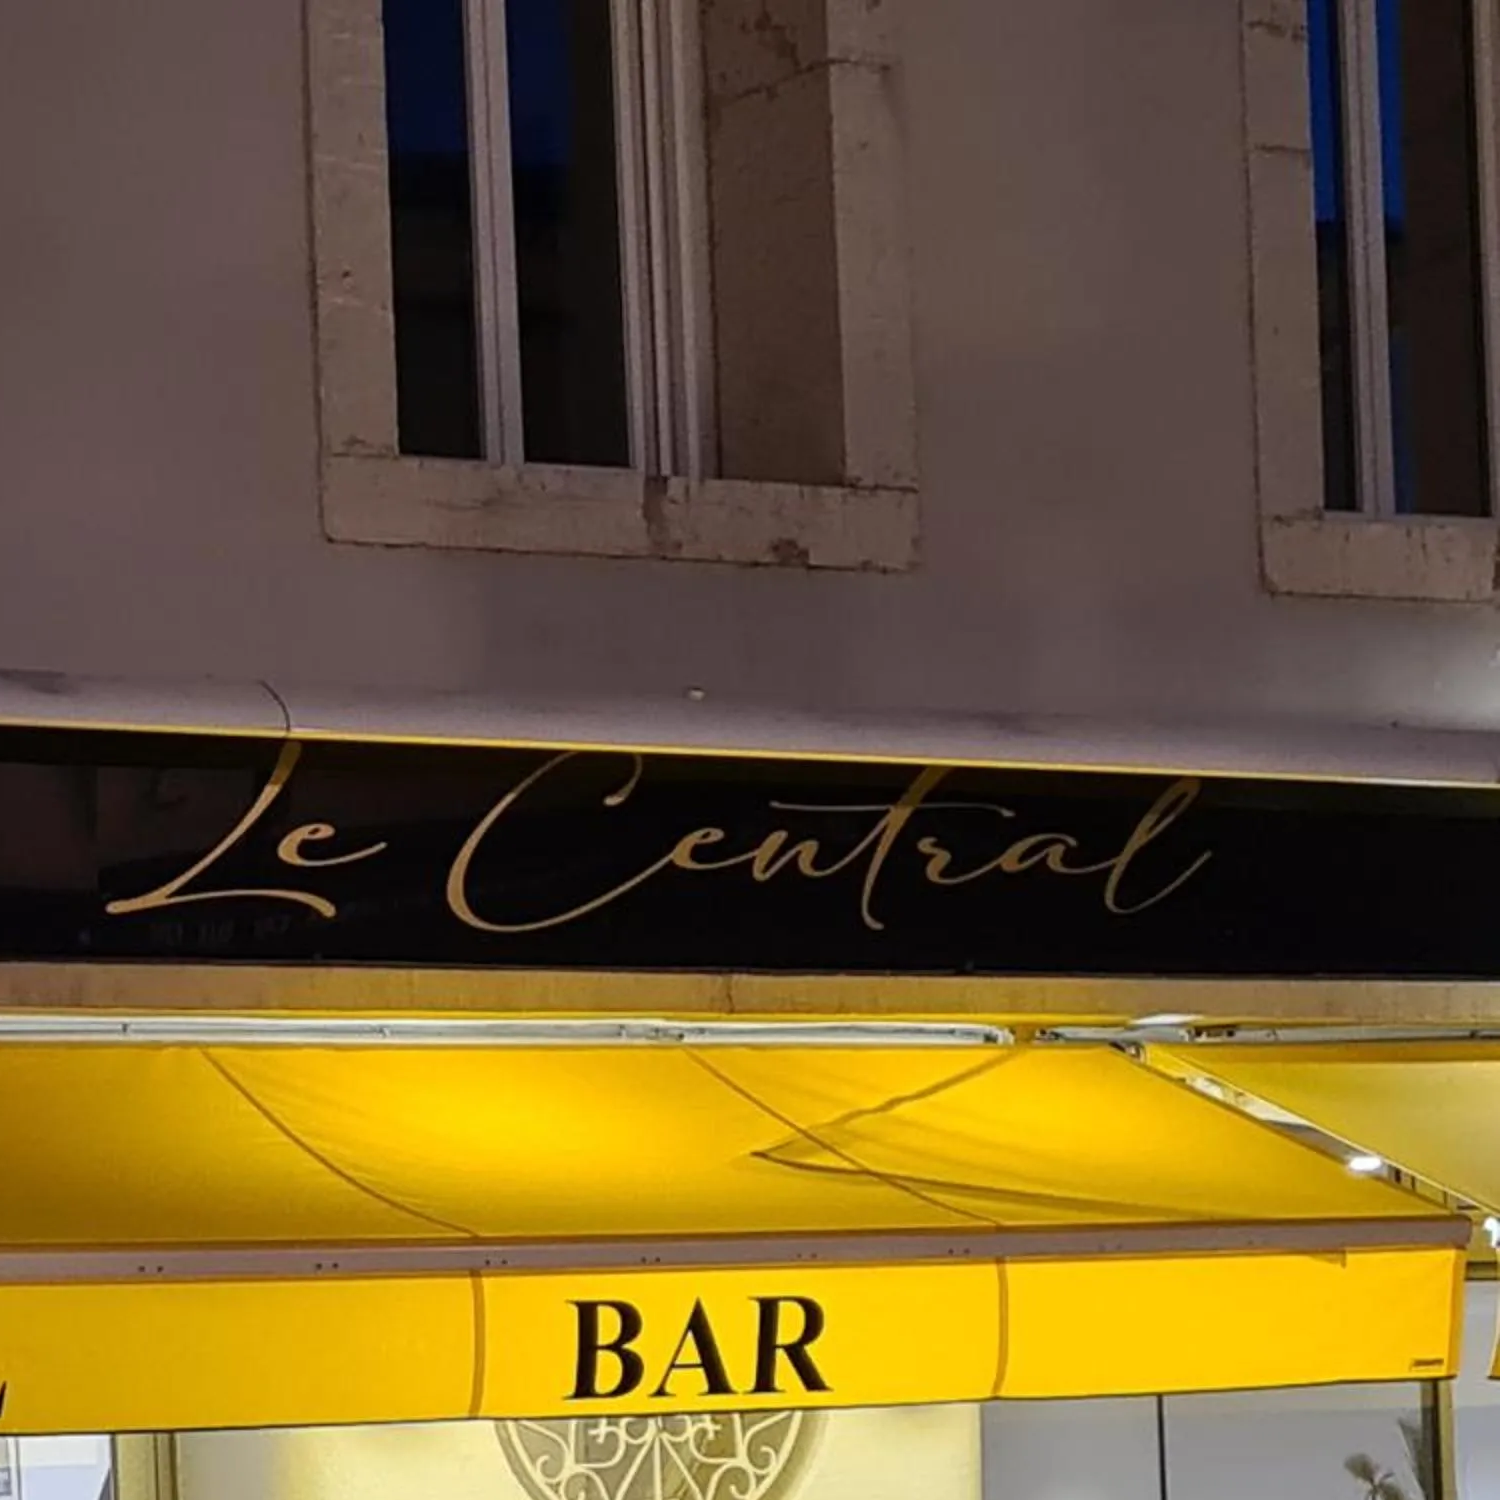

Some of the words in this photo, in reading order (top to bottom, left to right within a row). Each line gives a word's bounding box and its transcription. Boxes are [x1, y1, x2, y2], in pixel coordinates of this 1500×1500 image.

[105, 740, 388, 918] Le
[446, 750, 1213, 932] Central
[562, 1296, 834, 1401] BAR
